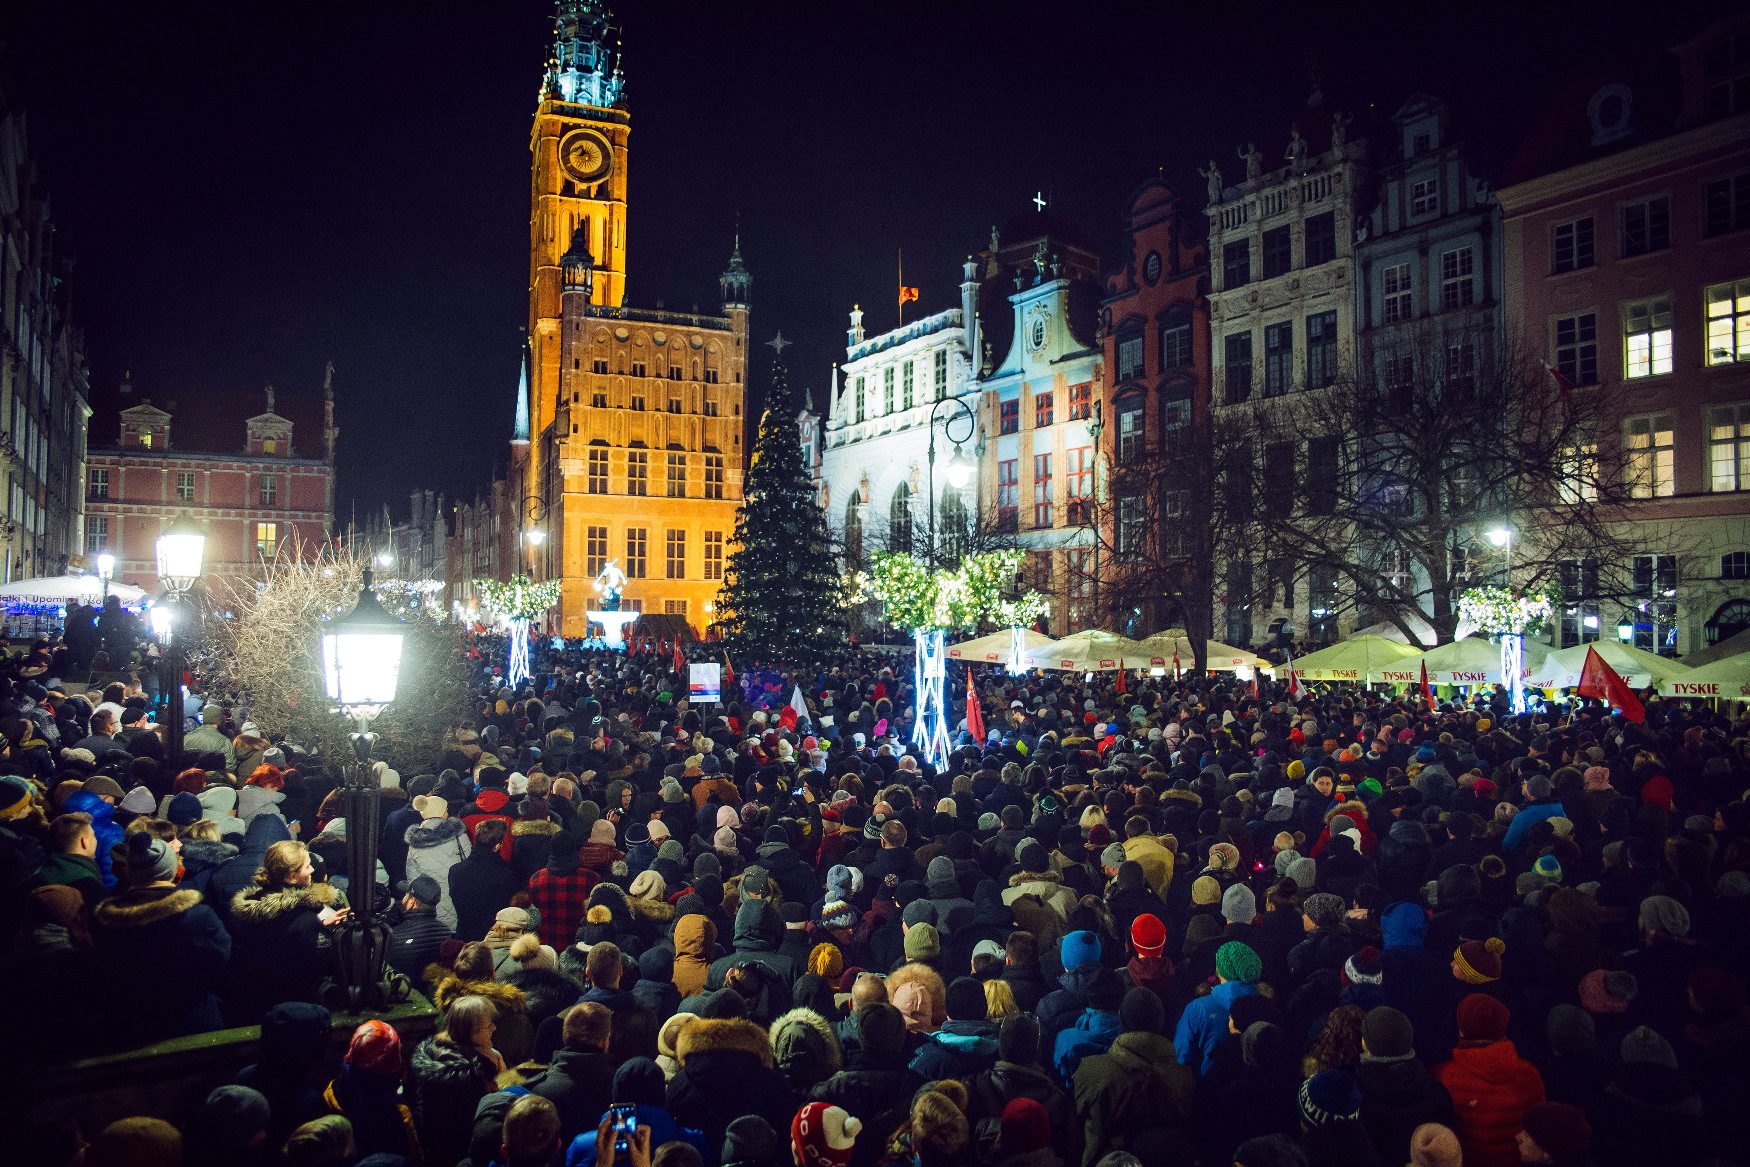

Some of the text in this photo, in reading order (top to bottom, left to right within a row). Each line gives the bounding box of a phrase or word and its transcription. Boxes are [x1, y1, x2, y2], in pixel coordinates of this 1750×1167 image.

[1332, 669, 1358, 678] TYSKIE
[1382, 671, 1415, 681] TYSKIE
[1451, 671, 1487, 681] TYSKIE
[1672, 683, 1720, 695] TYSKIE
